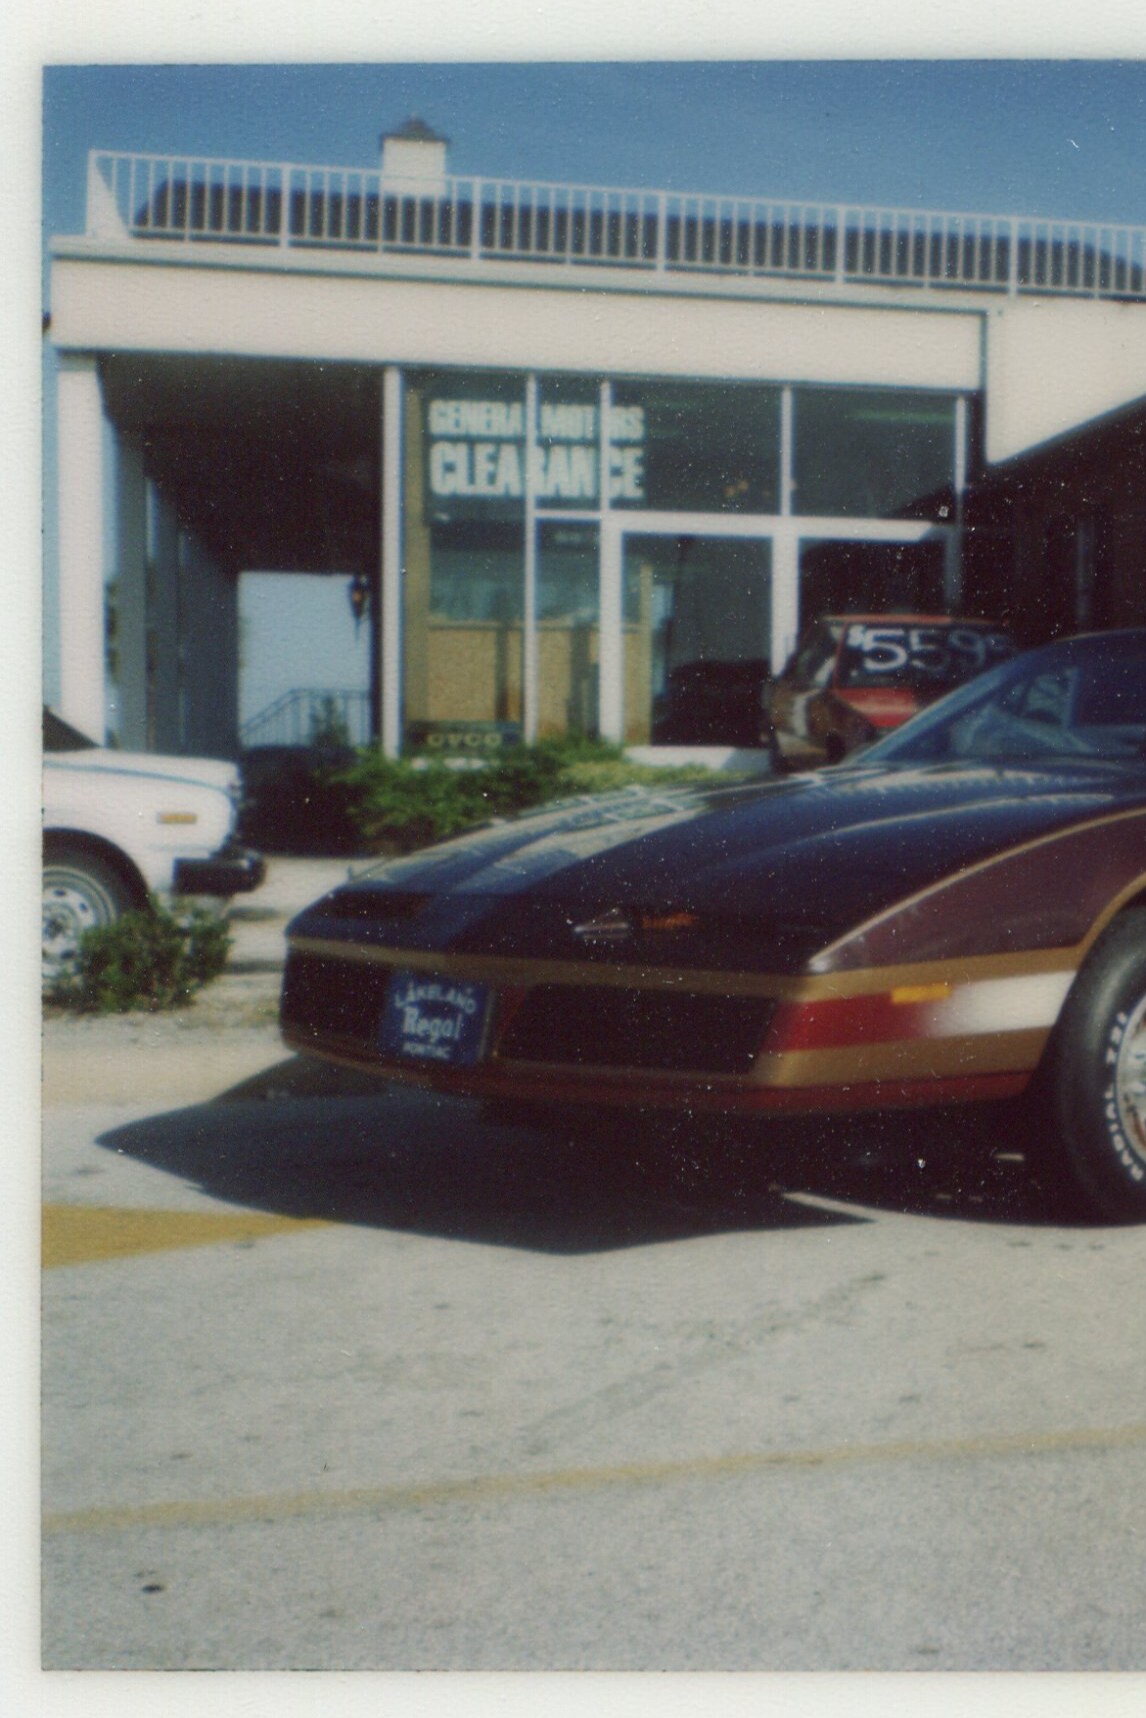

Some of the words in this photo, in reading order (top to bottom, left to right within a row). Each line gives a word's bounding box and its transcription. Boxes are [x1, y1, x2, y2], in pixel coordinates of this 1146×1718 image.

[429, 400, 536, 436] GENERA
[541, 404, 644, 439] MOTRS
[403, 1007, 462, 1042] Regal
